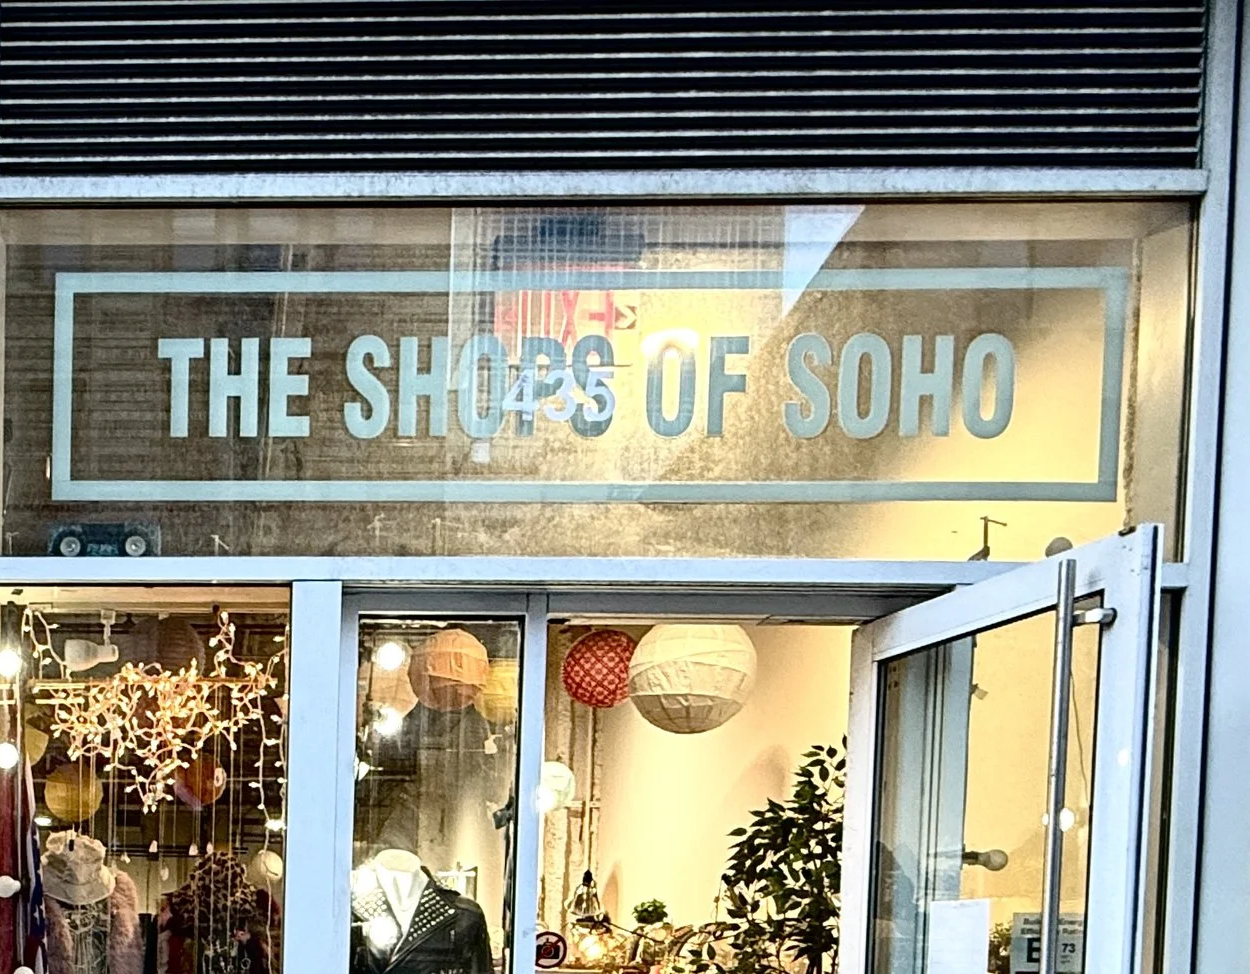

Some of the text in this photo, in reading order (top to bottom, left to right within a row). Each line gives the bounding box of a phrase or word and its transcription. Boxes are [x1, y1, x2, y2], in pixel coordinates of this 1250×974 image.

[157, 332, 1016, 439] THE SHOPS OF SOHO
[502, 369, 616, 422] 435
[1062, 943, 1076, 953] 73
